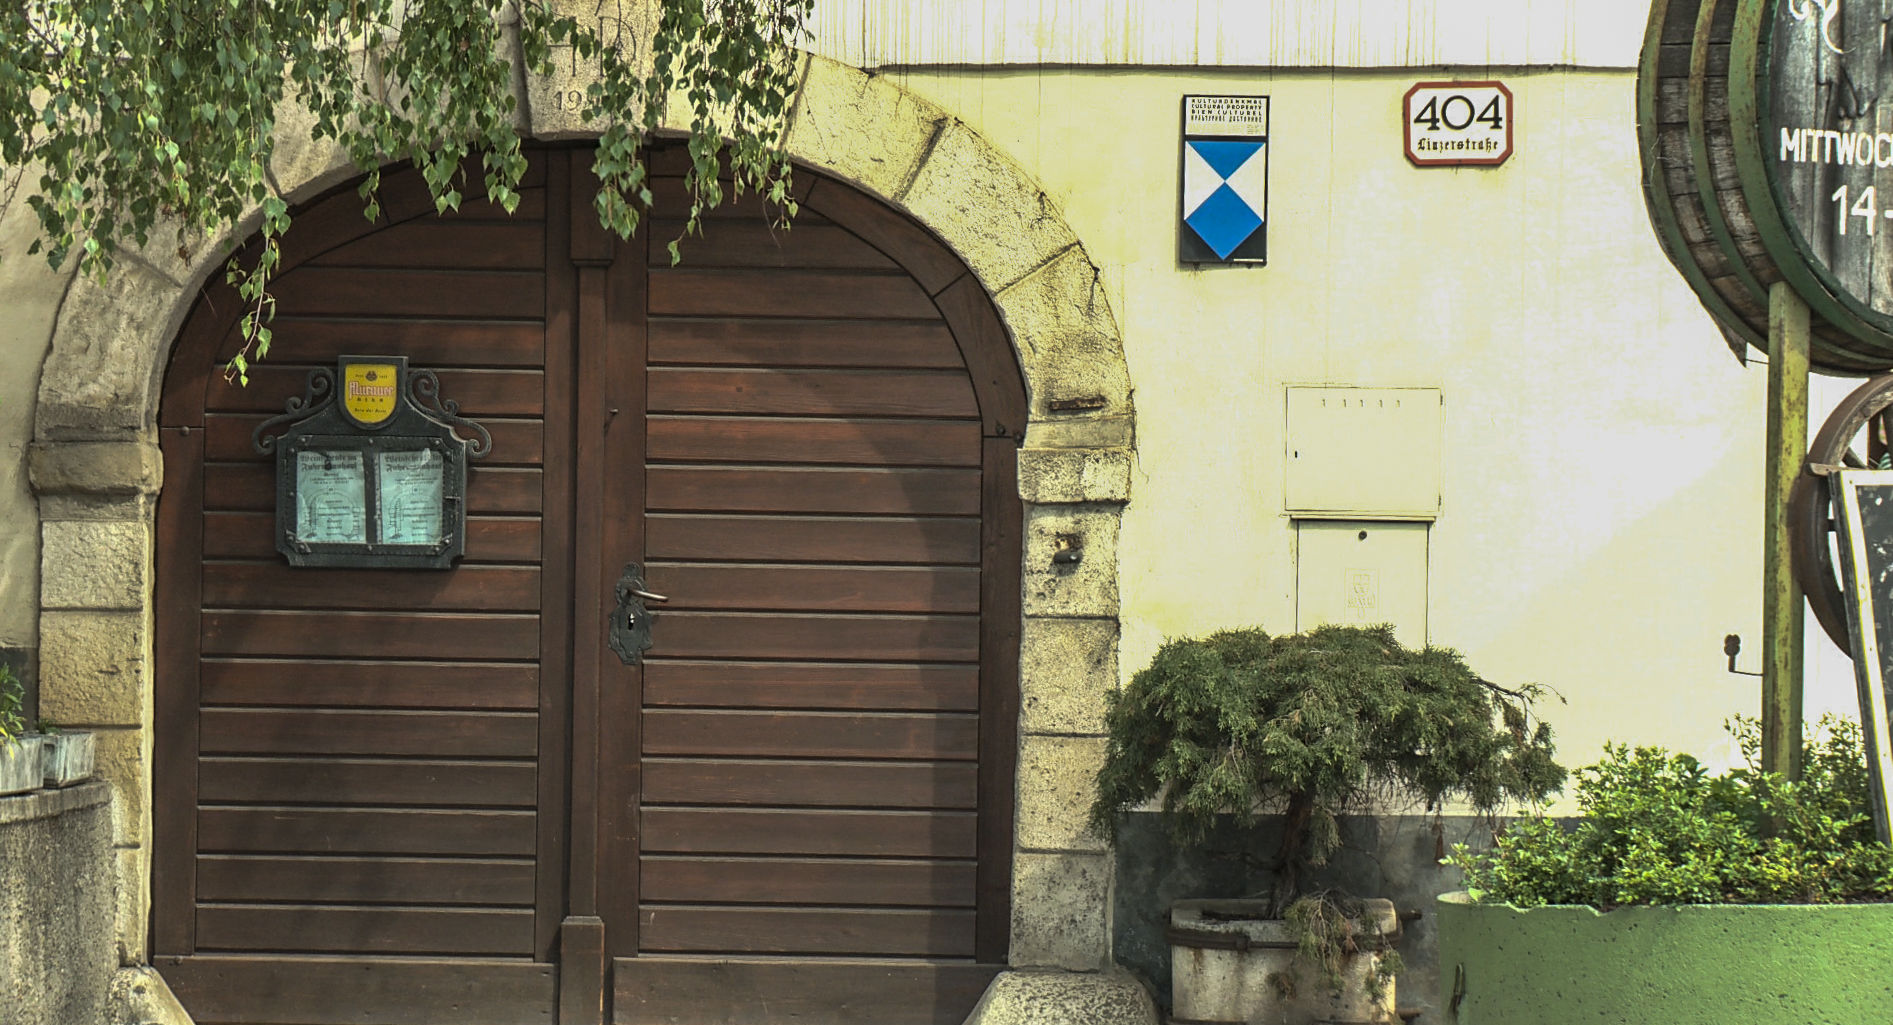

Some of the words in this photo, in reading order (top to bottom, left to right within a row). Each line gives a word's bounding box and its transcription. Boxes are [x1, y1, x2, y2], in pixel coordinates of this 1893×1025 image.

[1413, 94, 1503, 131] 404
[1417, 137, 1498, 153] Linzerstraße
[1780, 127, 1893, 168] MITTWOC
